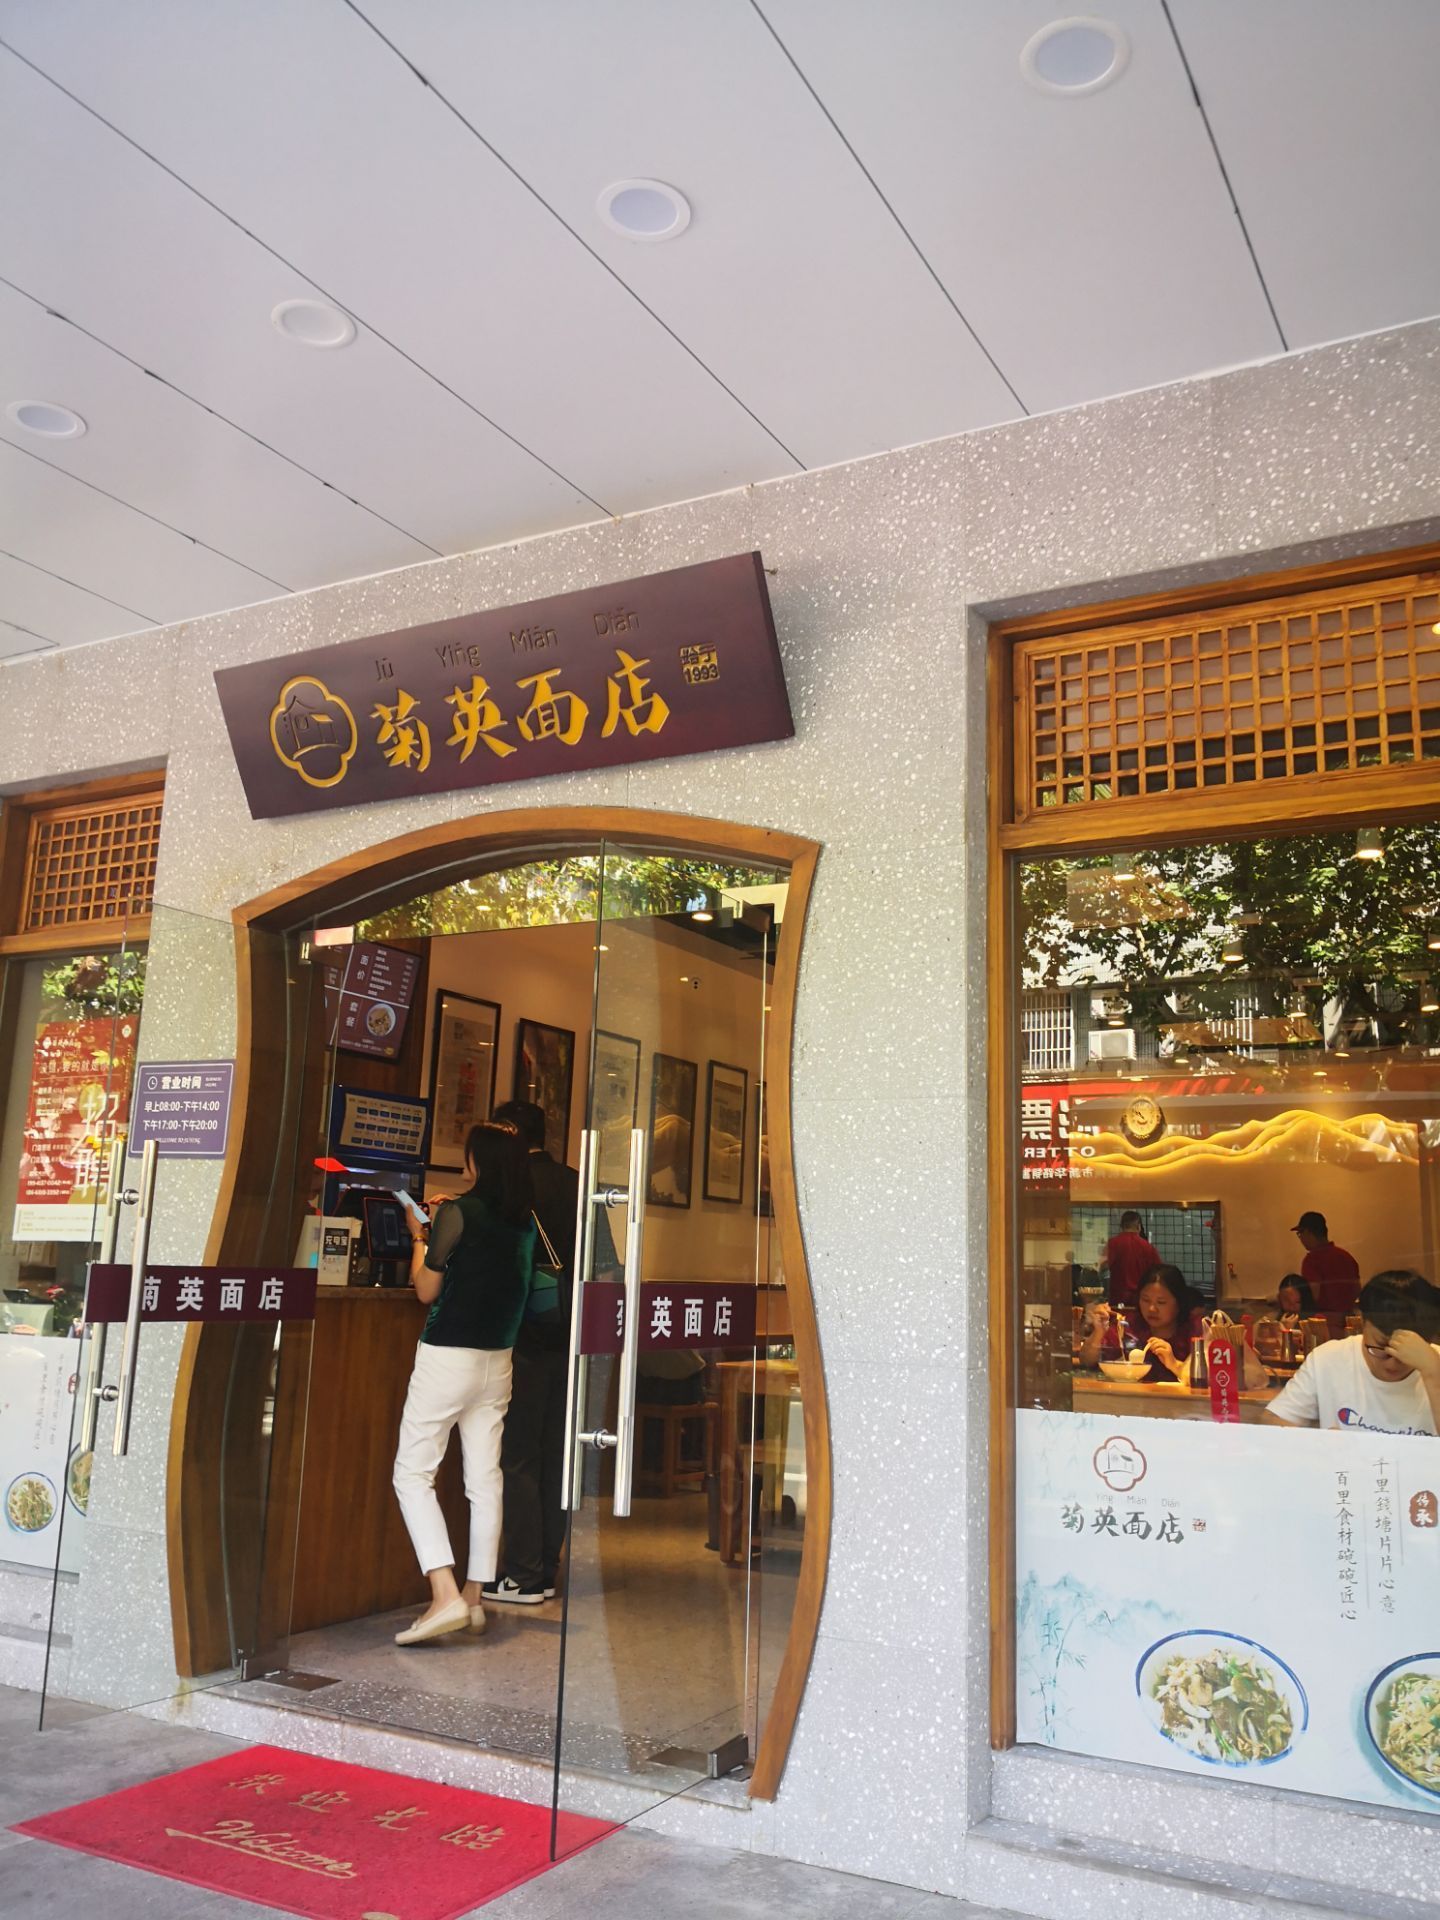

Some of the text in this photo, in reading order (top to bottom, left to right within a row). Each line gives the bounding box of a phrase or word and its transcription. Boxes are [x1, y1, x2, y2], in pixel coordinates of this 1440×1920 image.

[684, 663, 719, 683] 1993
[369, 649, 670, 772] 菊英面店
[161, 1075, 202, 1090] 营业时间
[144, 1100, 220, 1113] 早上08:00-下午14:00
[143, 1120, 218, 1132] 下午17:00-下午20:00
[1212, 1347, 1231, 1365] 21
[1061, 1502, 1184, 1545] 菊英面店
[1335, 1470, 1358, 1620] 百里食材碗碗匠心
[200, 1819, 354, 1873] Welcome
